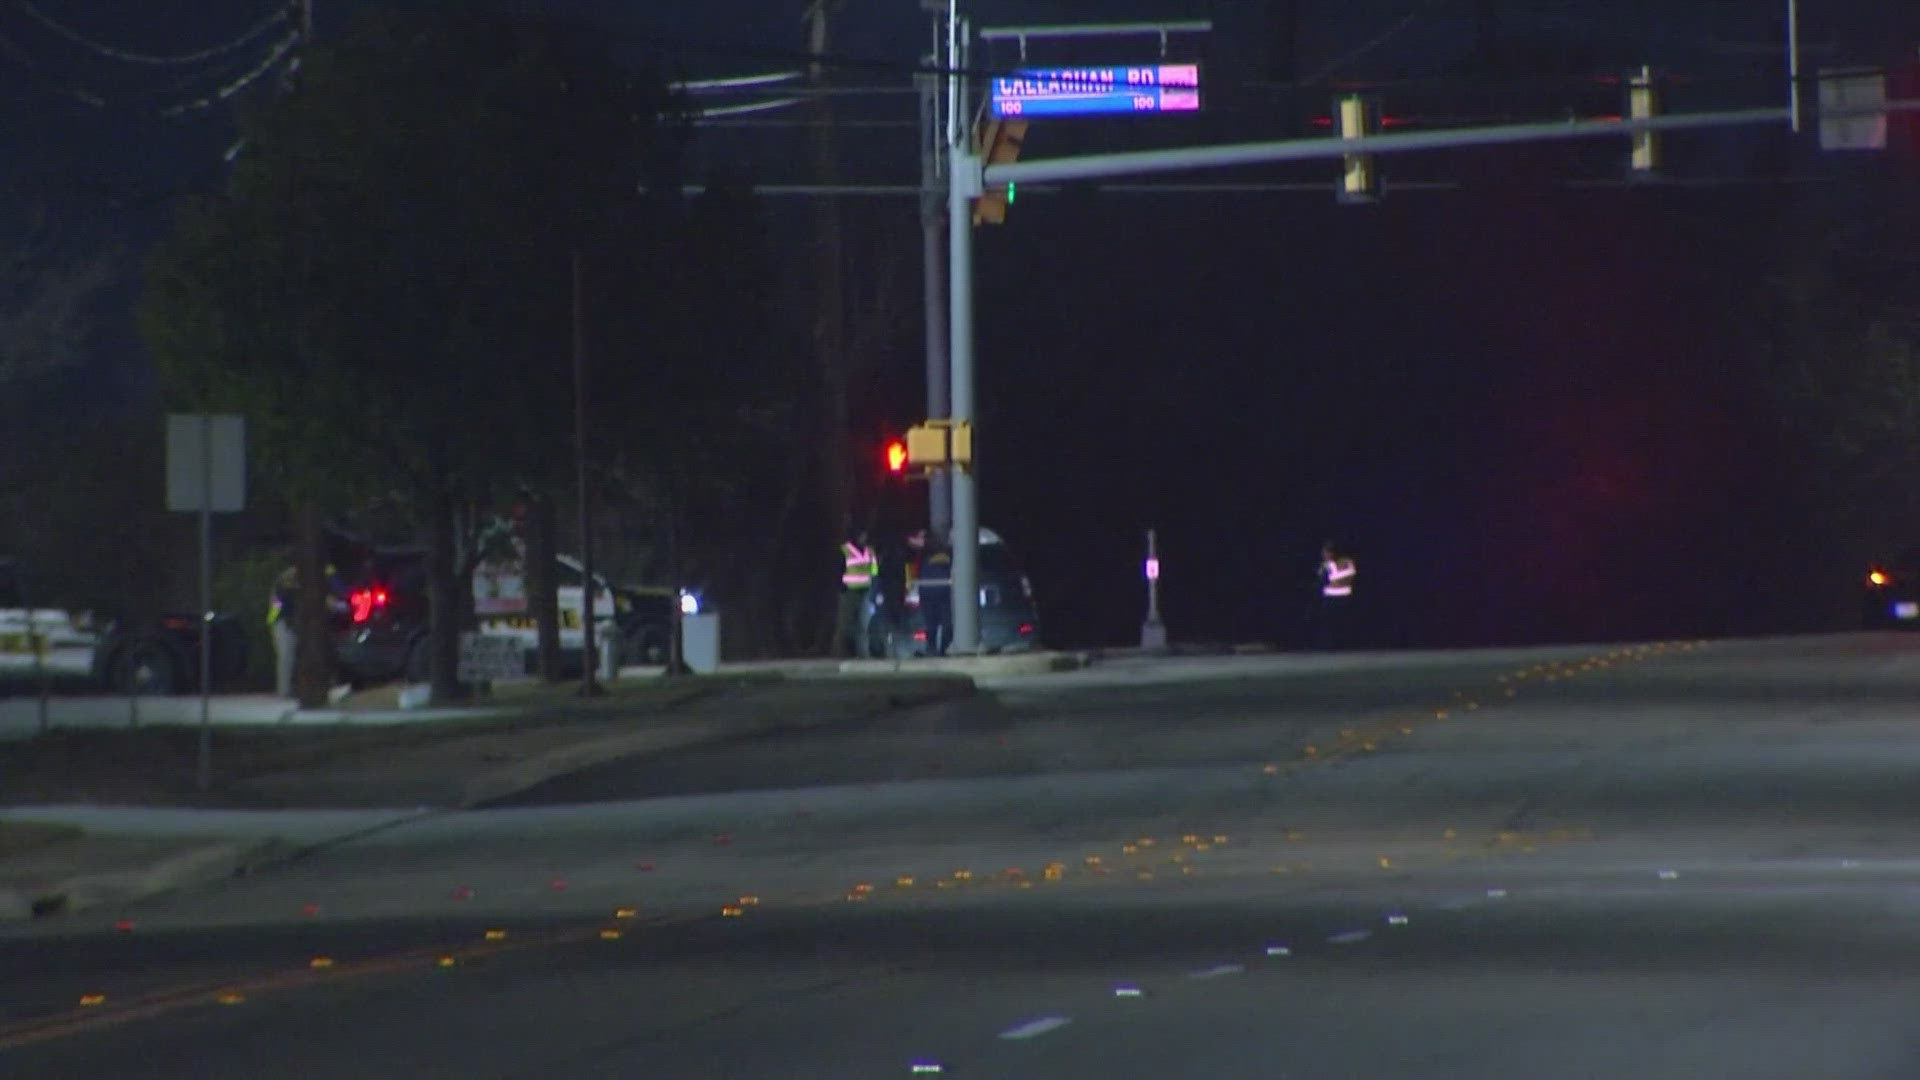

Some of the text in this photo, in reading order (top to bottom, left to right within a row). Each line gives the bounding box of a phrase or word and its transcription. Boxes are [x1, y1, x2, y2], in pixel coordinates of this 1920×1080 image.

[999, 69, 1114, 97] CALLAGHAN
[1127, 67, 1154, 88] RD
[1001, 101, 1022, 115] 100
[1133, 96, 1154, 110] 100
